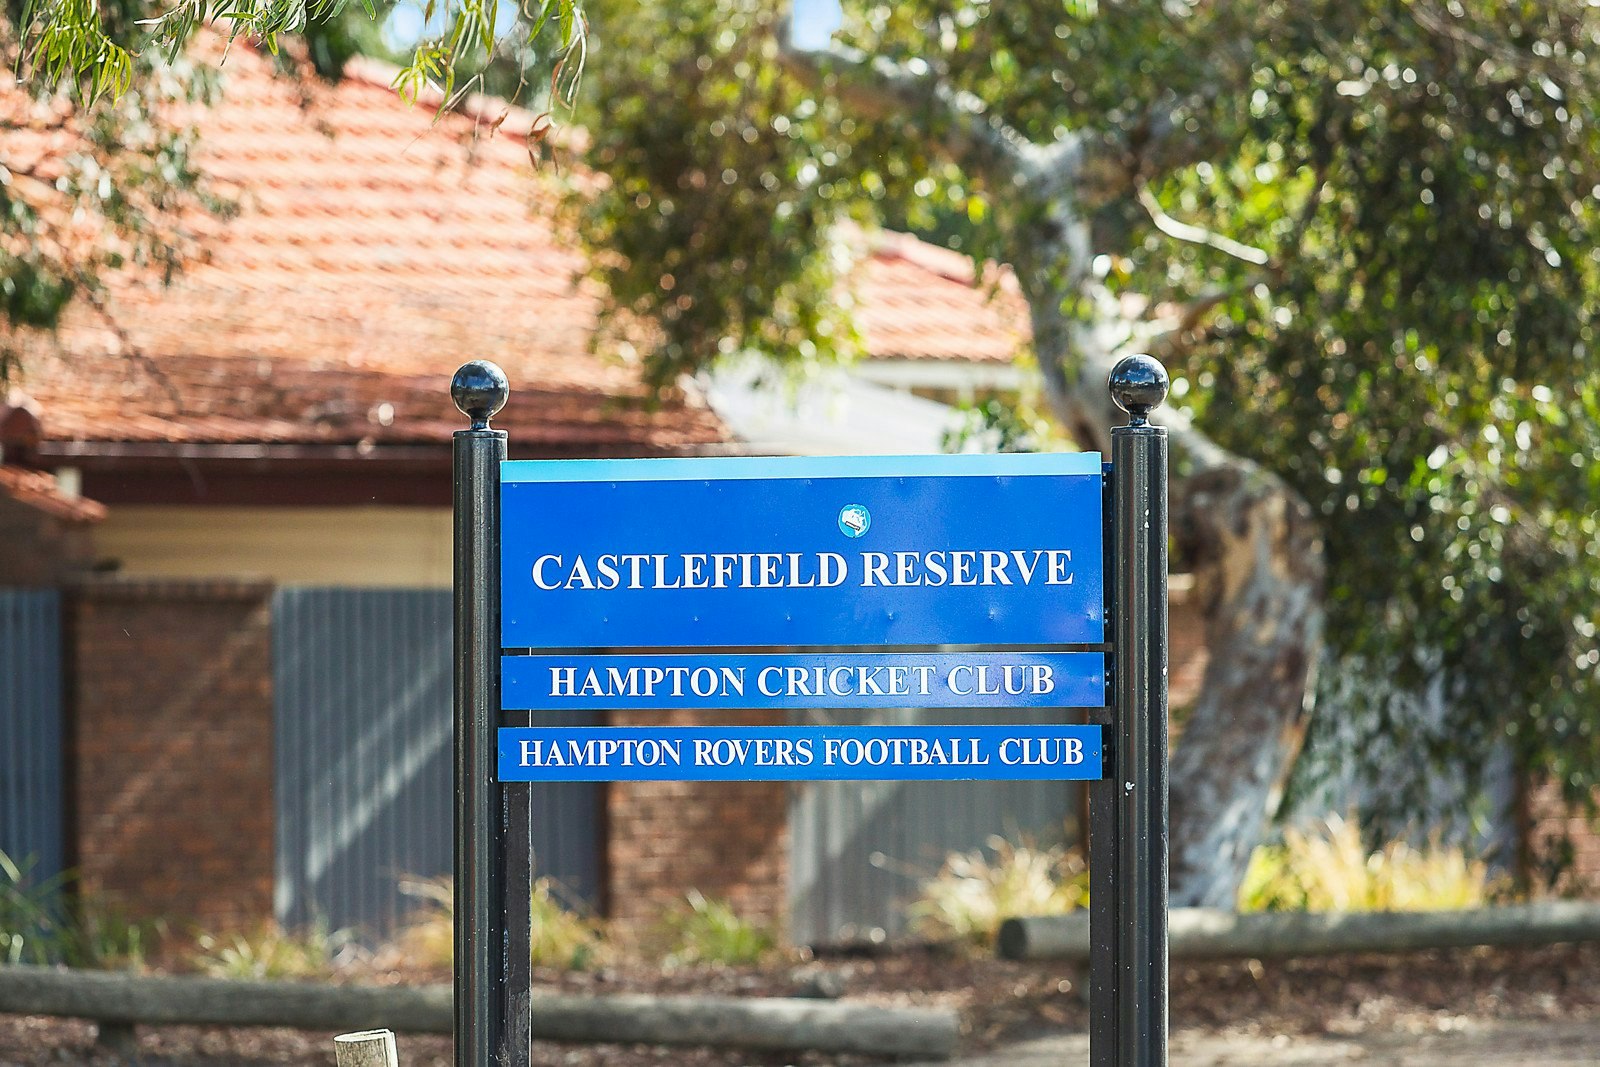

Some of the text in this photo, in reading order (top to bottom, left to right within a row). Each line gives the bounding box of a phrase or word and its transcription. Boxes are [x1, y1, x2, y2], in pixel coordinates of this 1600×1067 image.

[532, 550, 1074, 590] CASTLEFIELD RESERVE
[548, 665, 1055, 697] HAMPTON CRICKET CLUB
[518, 738, 1084, 767] HAMPTON ROVERS FOOTBALL CLUB
